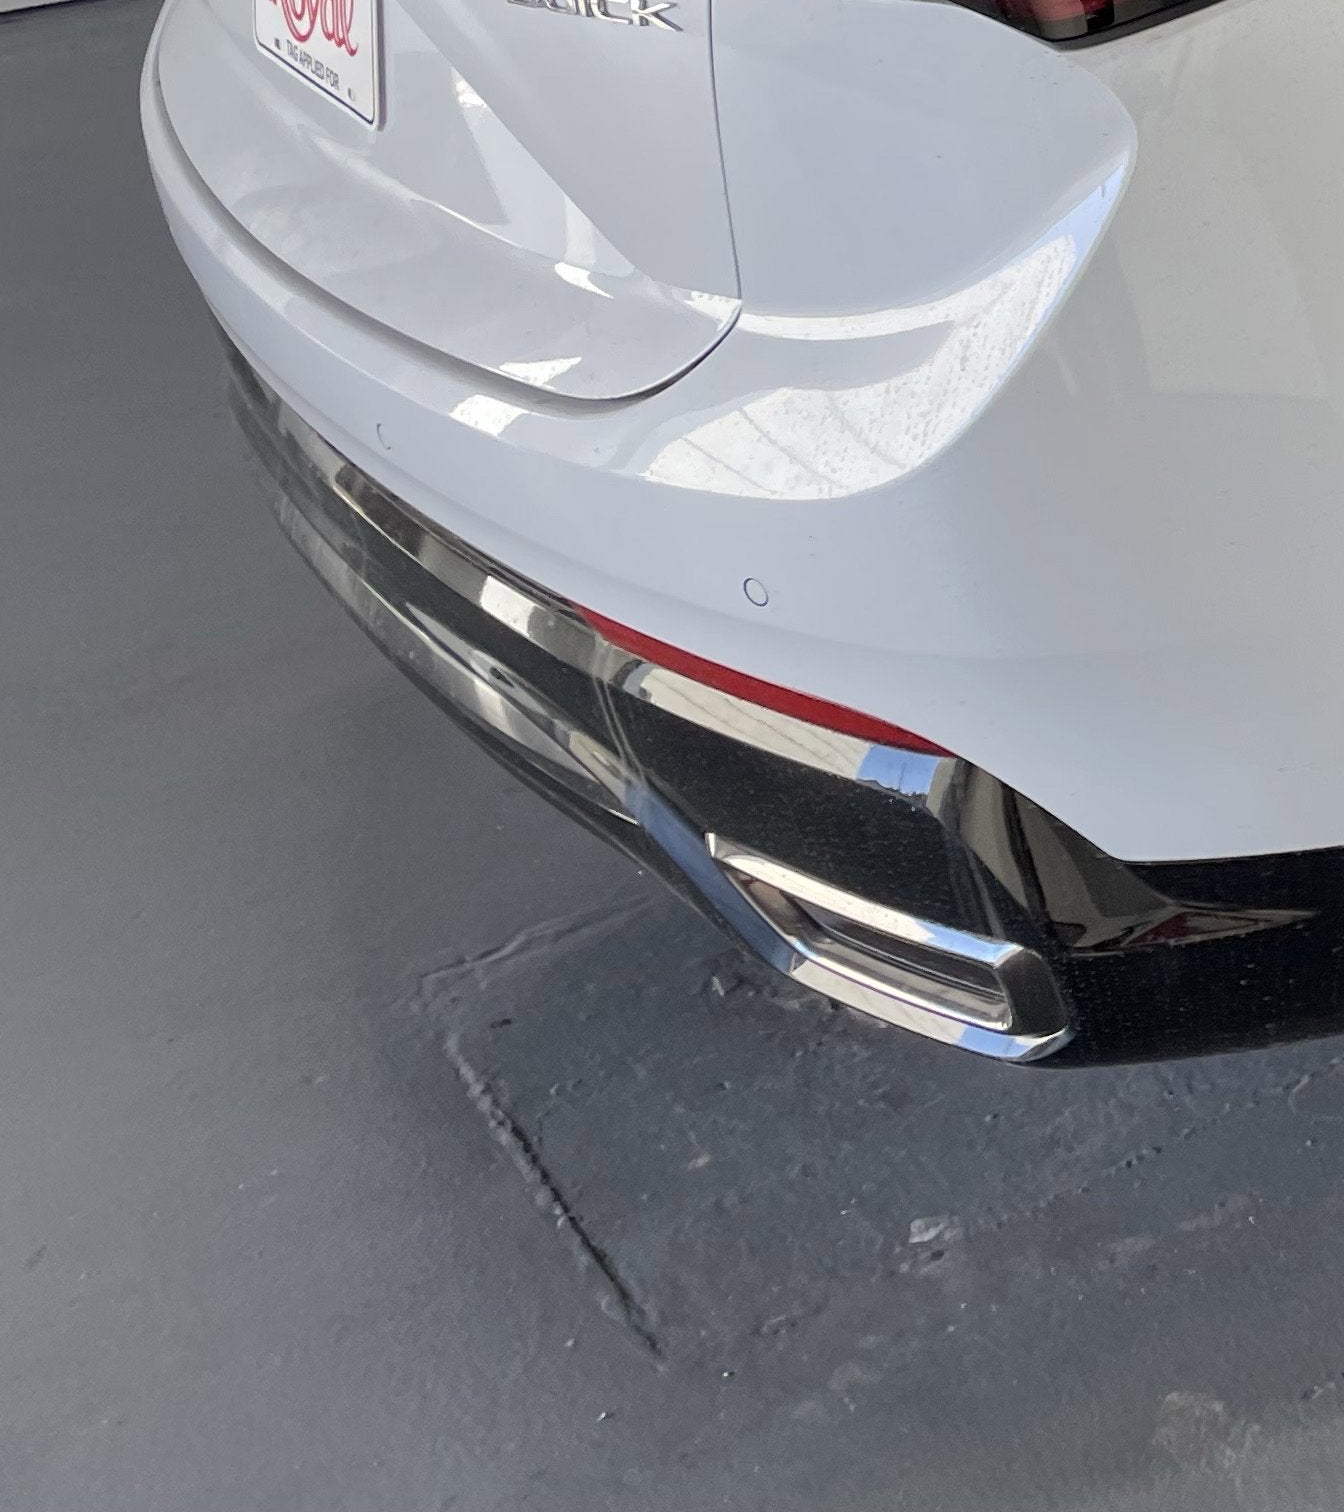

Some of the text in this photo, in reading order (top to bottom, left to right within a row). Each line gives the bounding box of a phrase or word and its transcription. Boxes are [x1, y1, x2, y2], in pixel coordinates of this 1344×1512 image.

[286, 39, 340, 91] TAG APPLIED FOR
